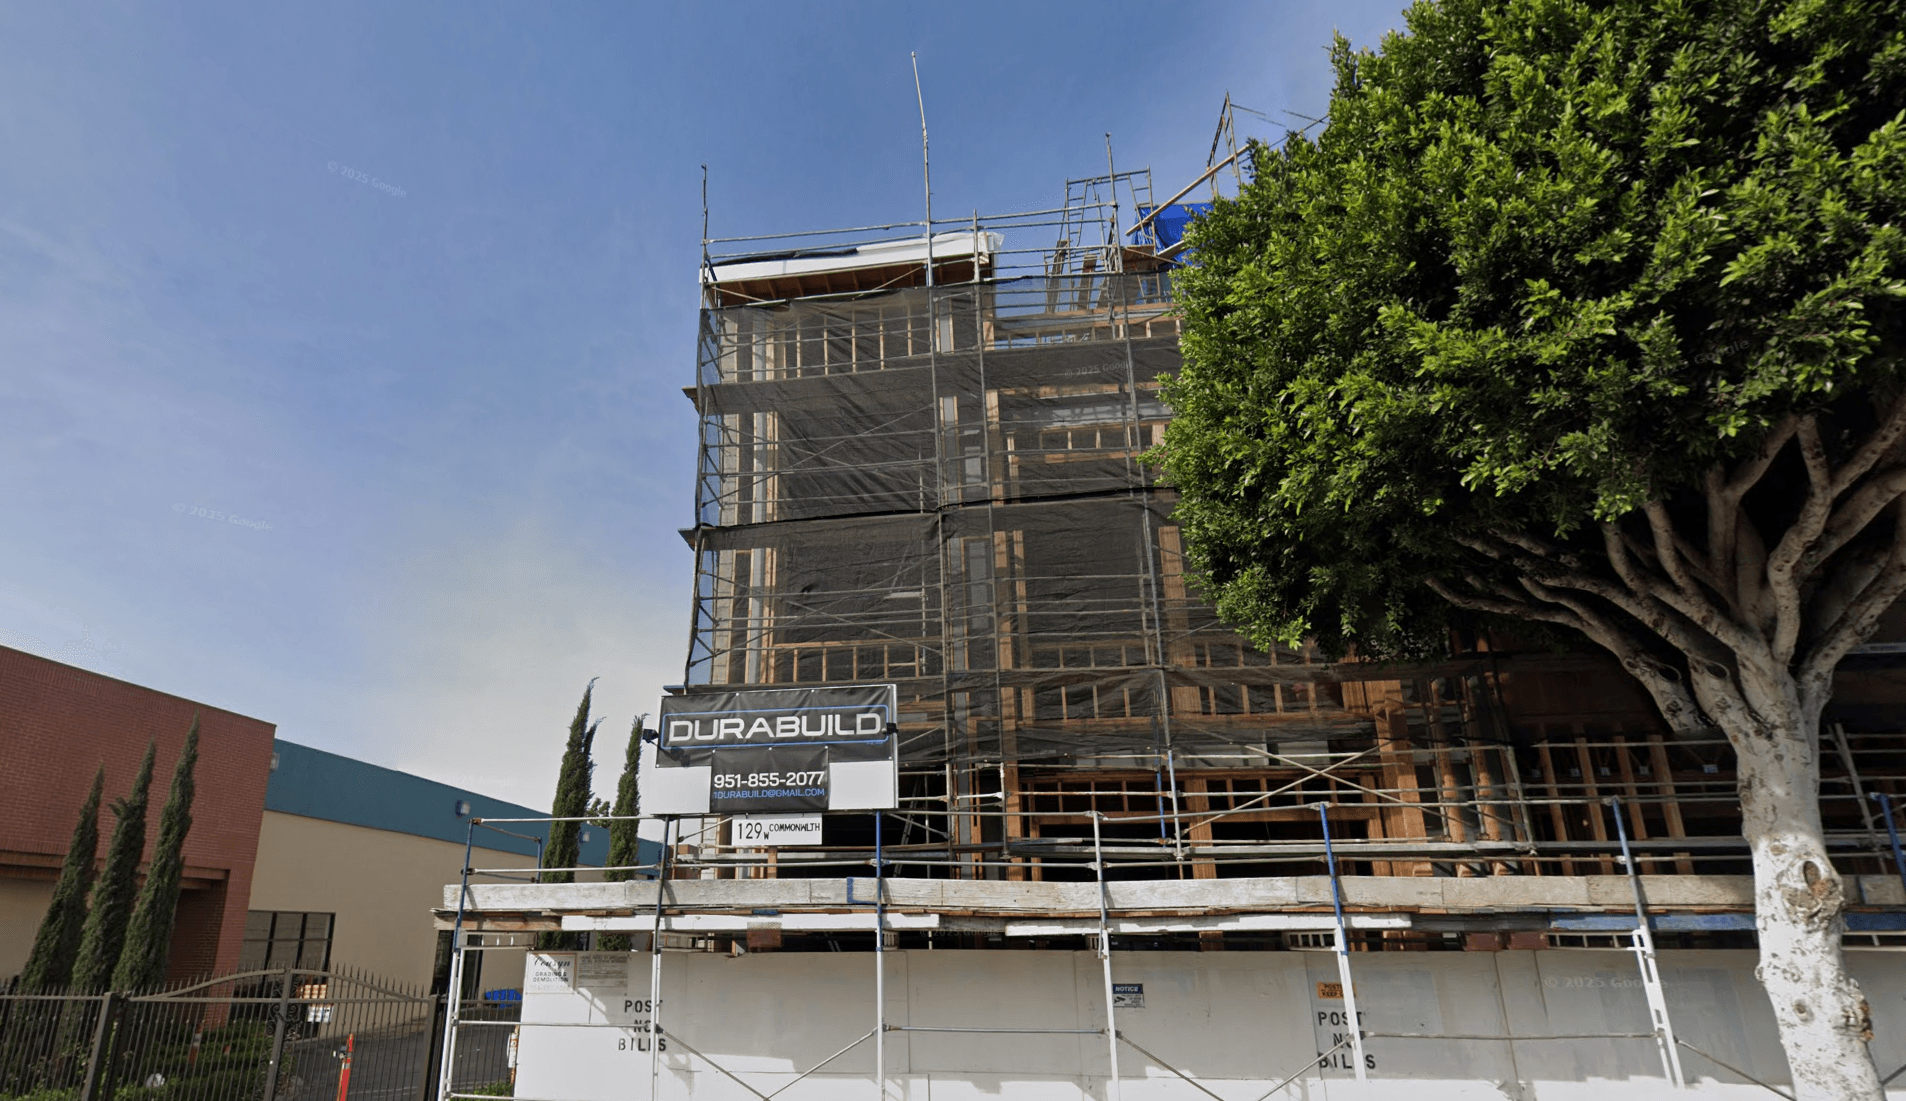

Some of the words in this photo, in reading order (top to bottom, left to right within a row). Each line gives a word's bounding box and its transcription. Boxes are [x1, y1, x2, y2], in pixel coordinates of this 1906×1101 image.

[669, 713, 881, 742] DURABUILD
[713, 771, 825, 788] 951-855-2077
[713, 788, 825, 799] 1DURABUILD@GMAIL.COM
[738, 822, 762, 839] 129
[769, 823, 820, 832] COMMONWLTH
[1318, 1052, 1376, 1069] BILS
